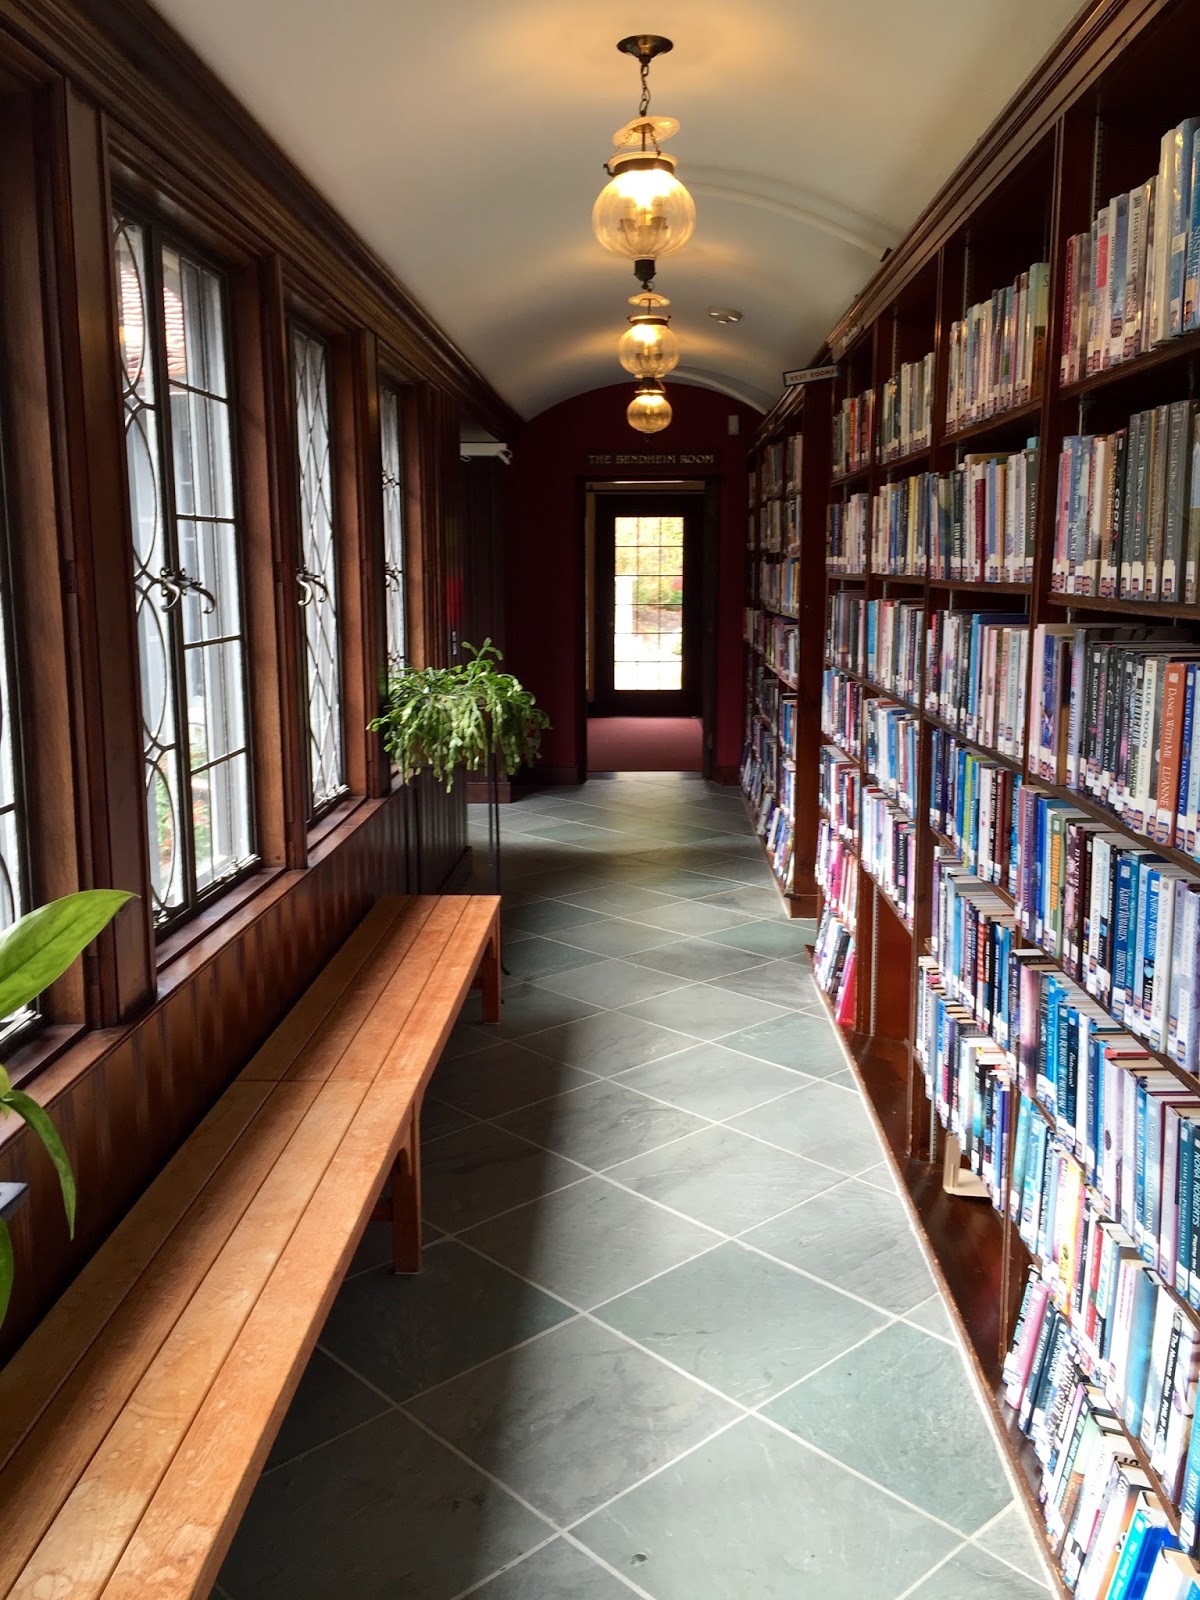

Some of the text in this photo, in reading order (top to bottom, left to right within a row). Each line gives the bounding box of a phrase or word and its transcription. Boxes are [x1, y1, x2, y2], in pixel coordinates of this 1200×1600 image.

[790, 374, 806, 382] REST
[588, 455, 611, 464] THE
[680, 454, 714, 464] ROOM
[1132, 688, 1142, 746] SCARECROW
[1142, 710, 1150, 748] MOON
[1160, 688, 1177, 806] DANCE WITH ME LUANNE
[1051, 834, 1061, 910] WEDDING RING
[1149, 895, 1159, 918] KAREN
[1116, 888, 1130, 986] KAREN ROBARDS IRRESISTIBLE
[1138, 918, 1146, 954] ROBARDS
[1148, 920, 1158, 956] ROBARDS
[1059, 1021, 1067, 1040] NORA
[1180, 1198, 1188, 1262] PERFORMANCE
[1048, 1332, 1065, 1381] JOHN SANDFORD
[1171, 1333, 1179, 1347] The
[1166, 1348, 1176, 1377] Human
[1163, 1376, 1172, 1397] Stain
[1160, 1399, 1169, 1426] PHILIP
